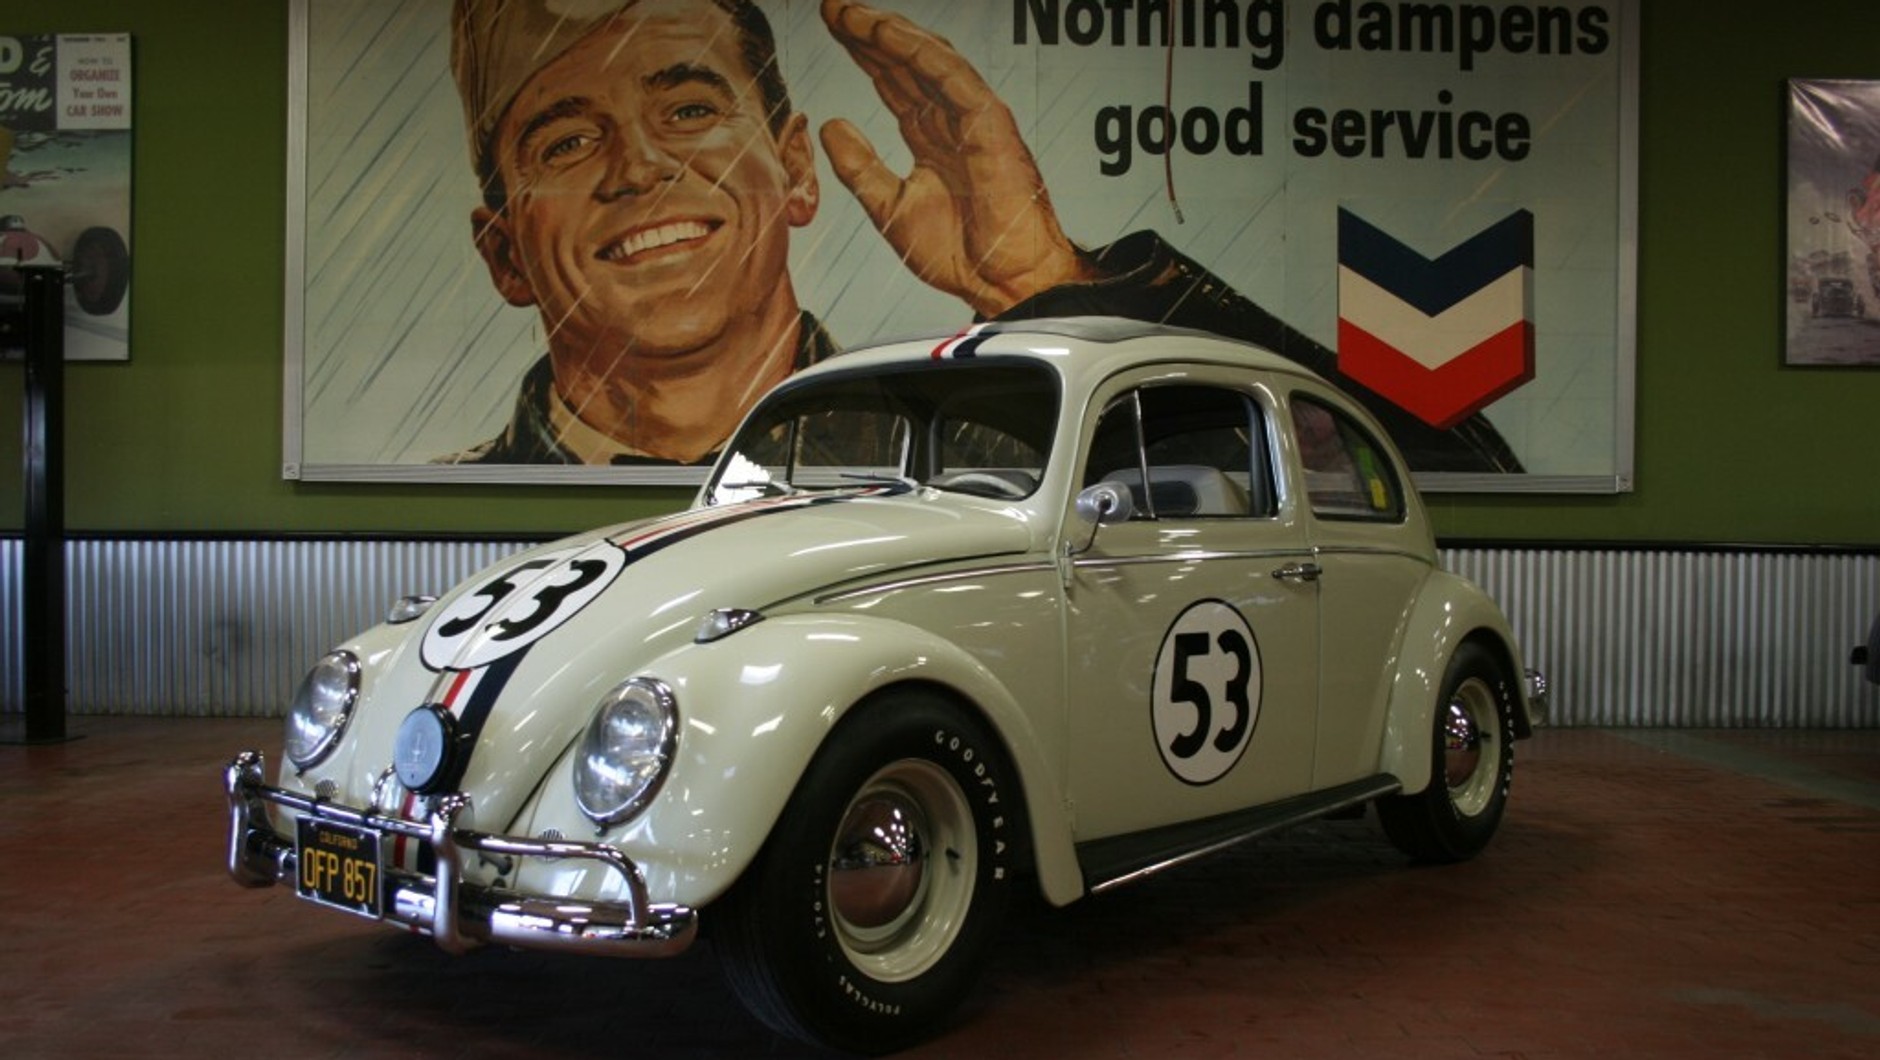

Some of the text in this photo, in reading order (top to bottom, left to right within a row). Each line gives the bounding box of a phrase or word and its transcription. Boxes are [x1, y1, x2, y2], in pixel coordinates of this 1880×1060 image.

[29, 46, 53, 77] &
[1013, 0, 1610, 71] Nothing dampens
[66, 105, 124, 118] CAR SHOW
[1094, 81, 1533, 177] good service
[438, 559, 608, 642] 53
[1169, 629, 1252, 759] 53
[934, 730, 1006, 880] GOODYEAR
[303, 846, 376, 904] OFP 857
